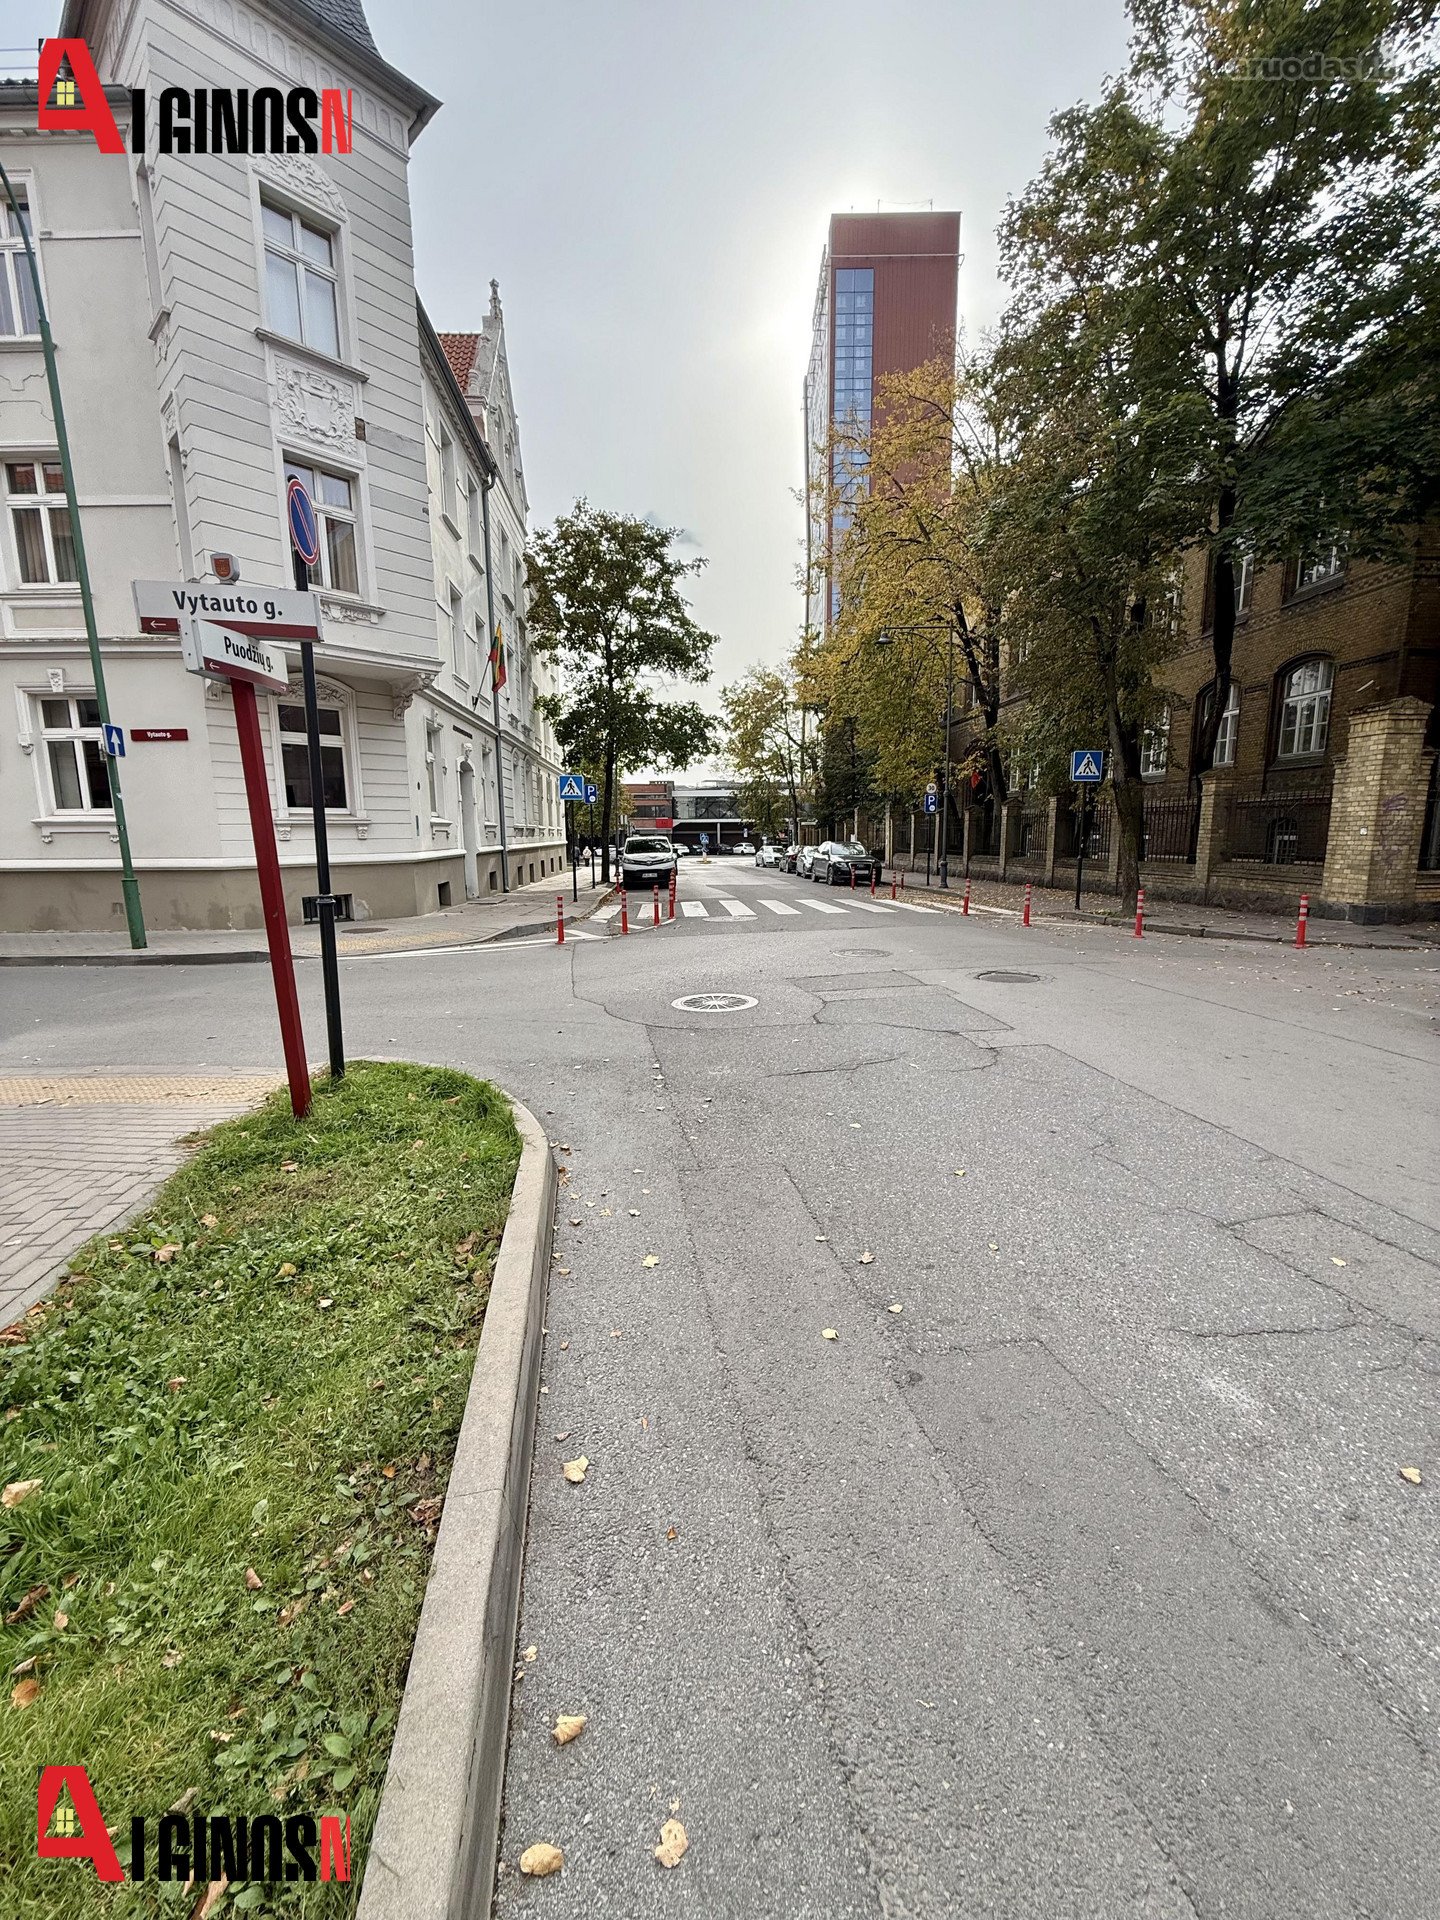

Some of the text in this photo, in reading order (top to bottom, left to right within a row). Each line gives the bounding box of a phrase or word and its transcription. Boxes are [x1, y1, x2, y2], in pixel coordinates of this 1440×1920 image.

[172, 590, 283, 620] Vytauto g.
[223, 635, 274, 673] Puodžių g.
[146, 731, 166, 739] Vytauto
[587, 785, 595, 796] P
[928, 795, 935, 805] P
